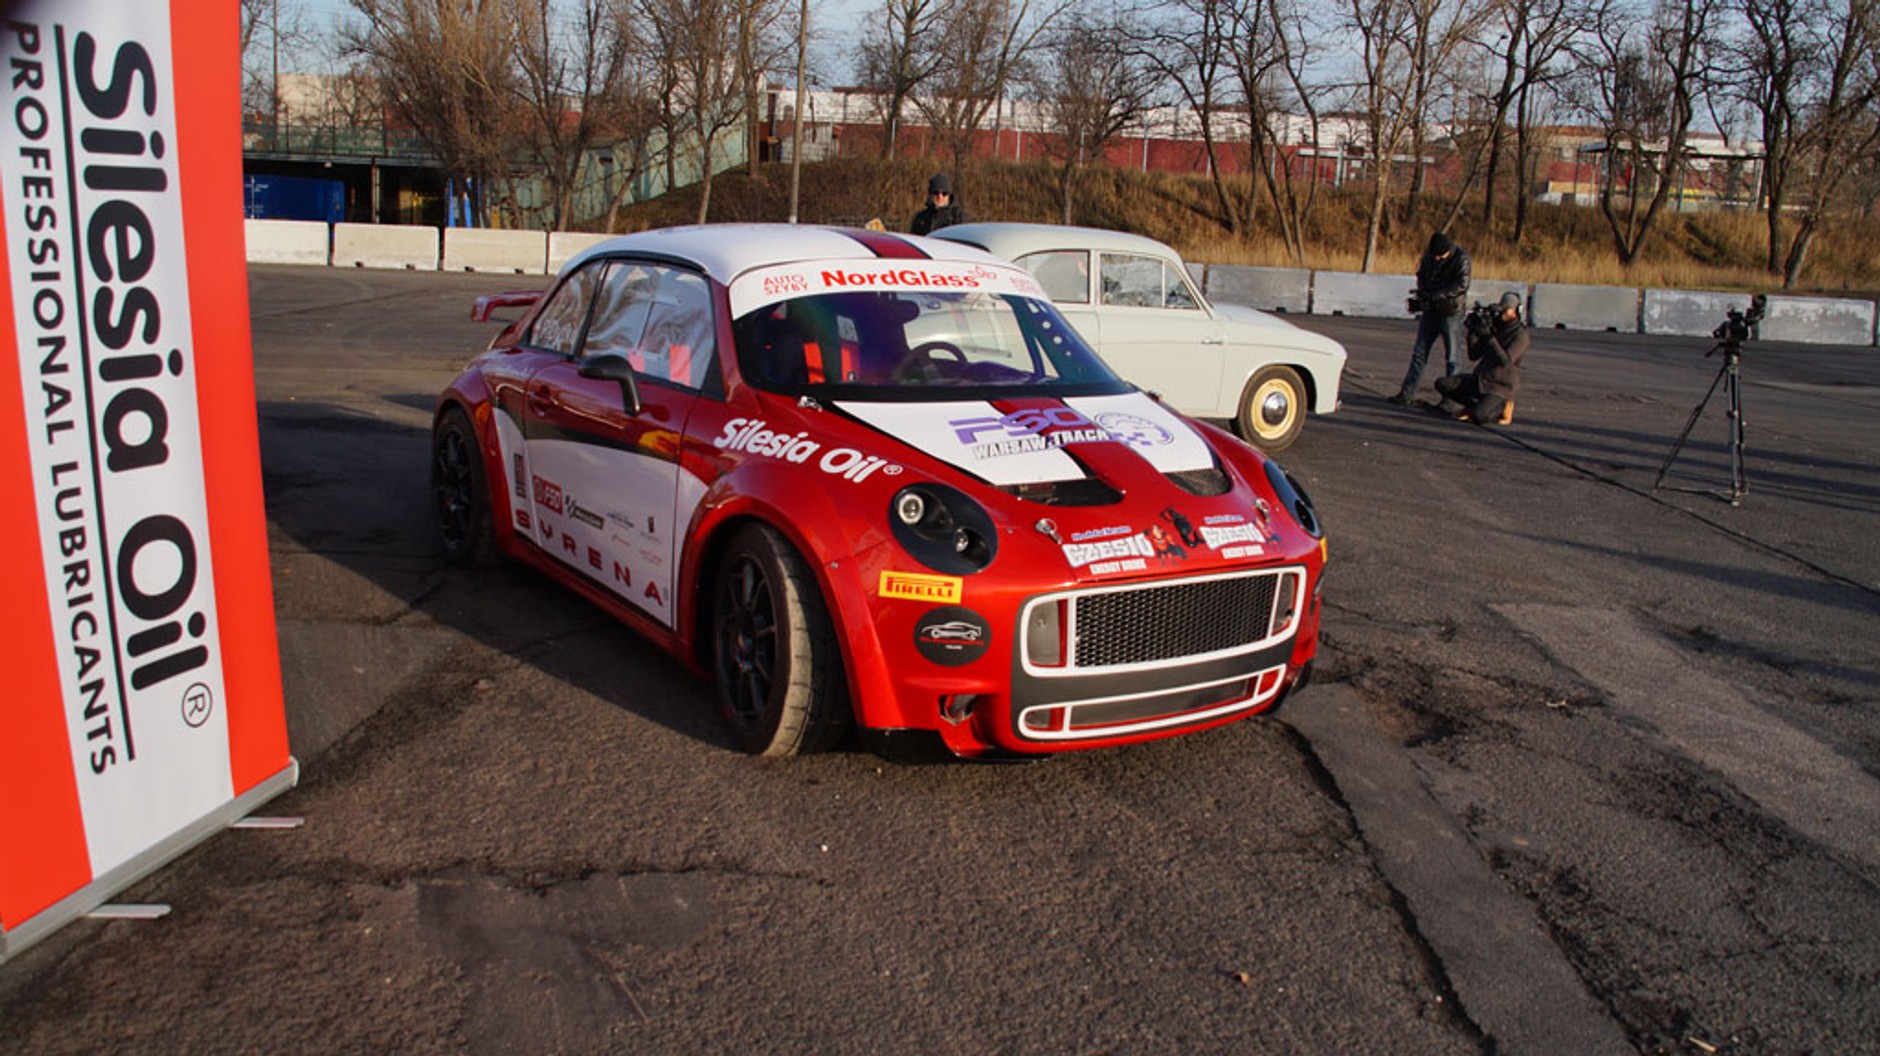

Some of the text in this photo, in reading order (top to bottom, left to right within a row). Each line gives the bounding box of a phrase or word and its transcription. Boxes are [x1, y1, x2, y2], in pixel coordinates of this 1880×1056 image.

[73, 31, 183, 473] Silesia
[820, 269, 980, 288] NordGlass
[7, 20, 117, 775] PROFESSIONAL LUBRICANTS
[713, 417, 821, 464] Silesia
[819, 447, 888, 484] Oil
[973, 436, 1047, 459] WARSAW
[515, 508, 664, 608] SYRENA
[886, 576, 954, 598] PIRELLI
[116, 513, 209, 691] Oil
